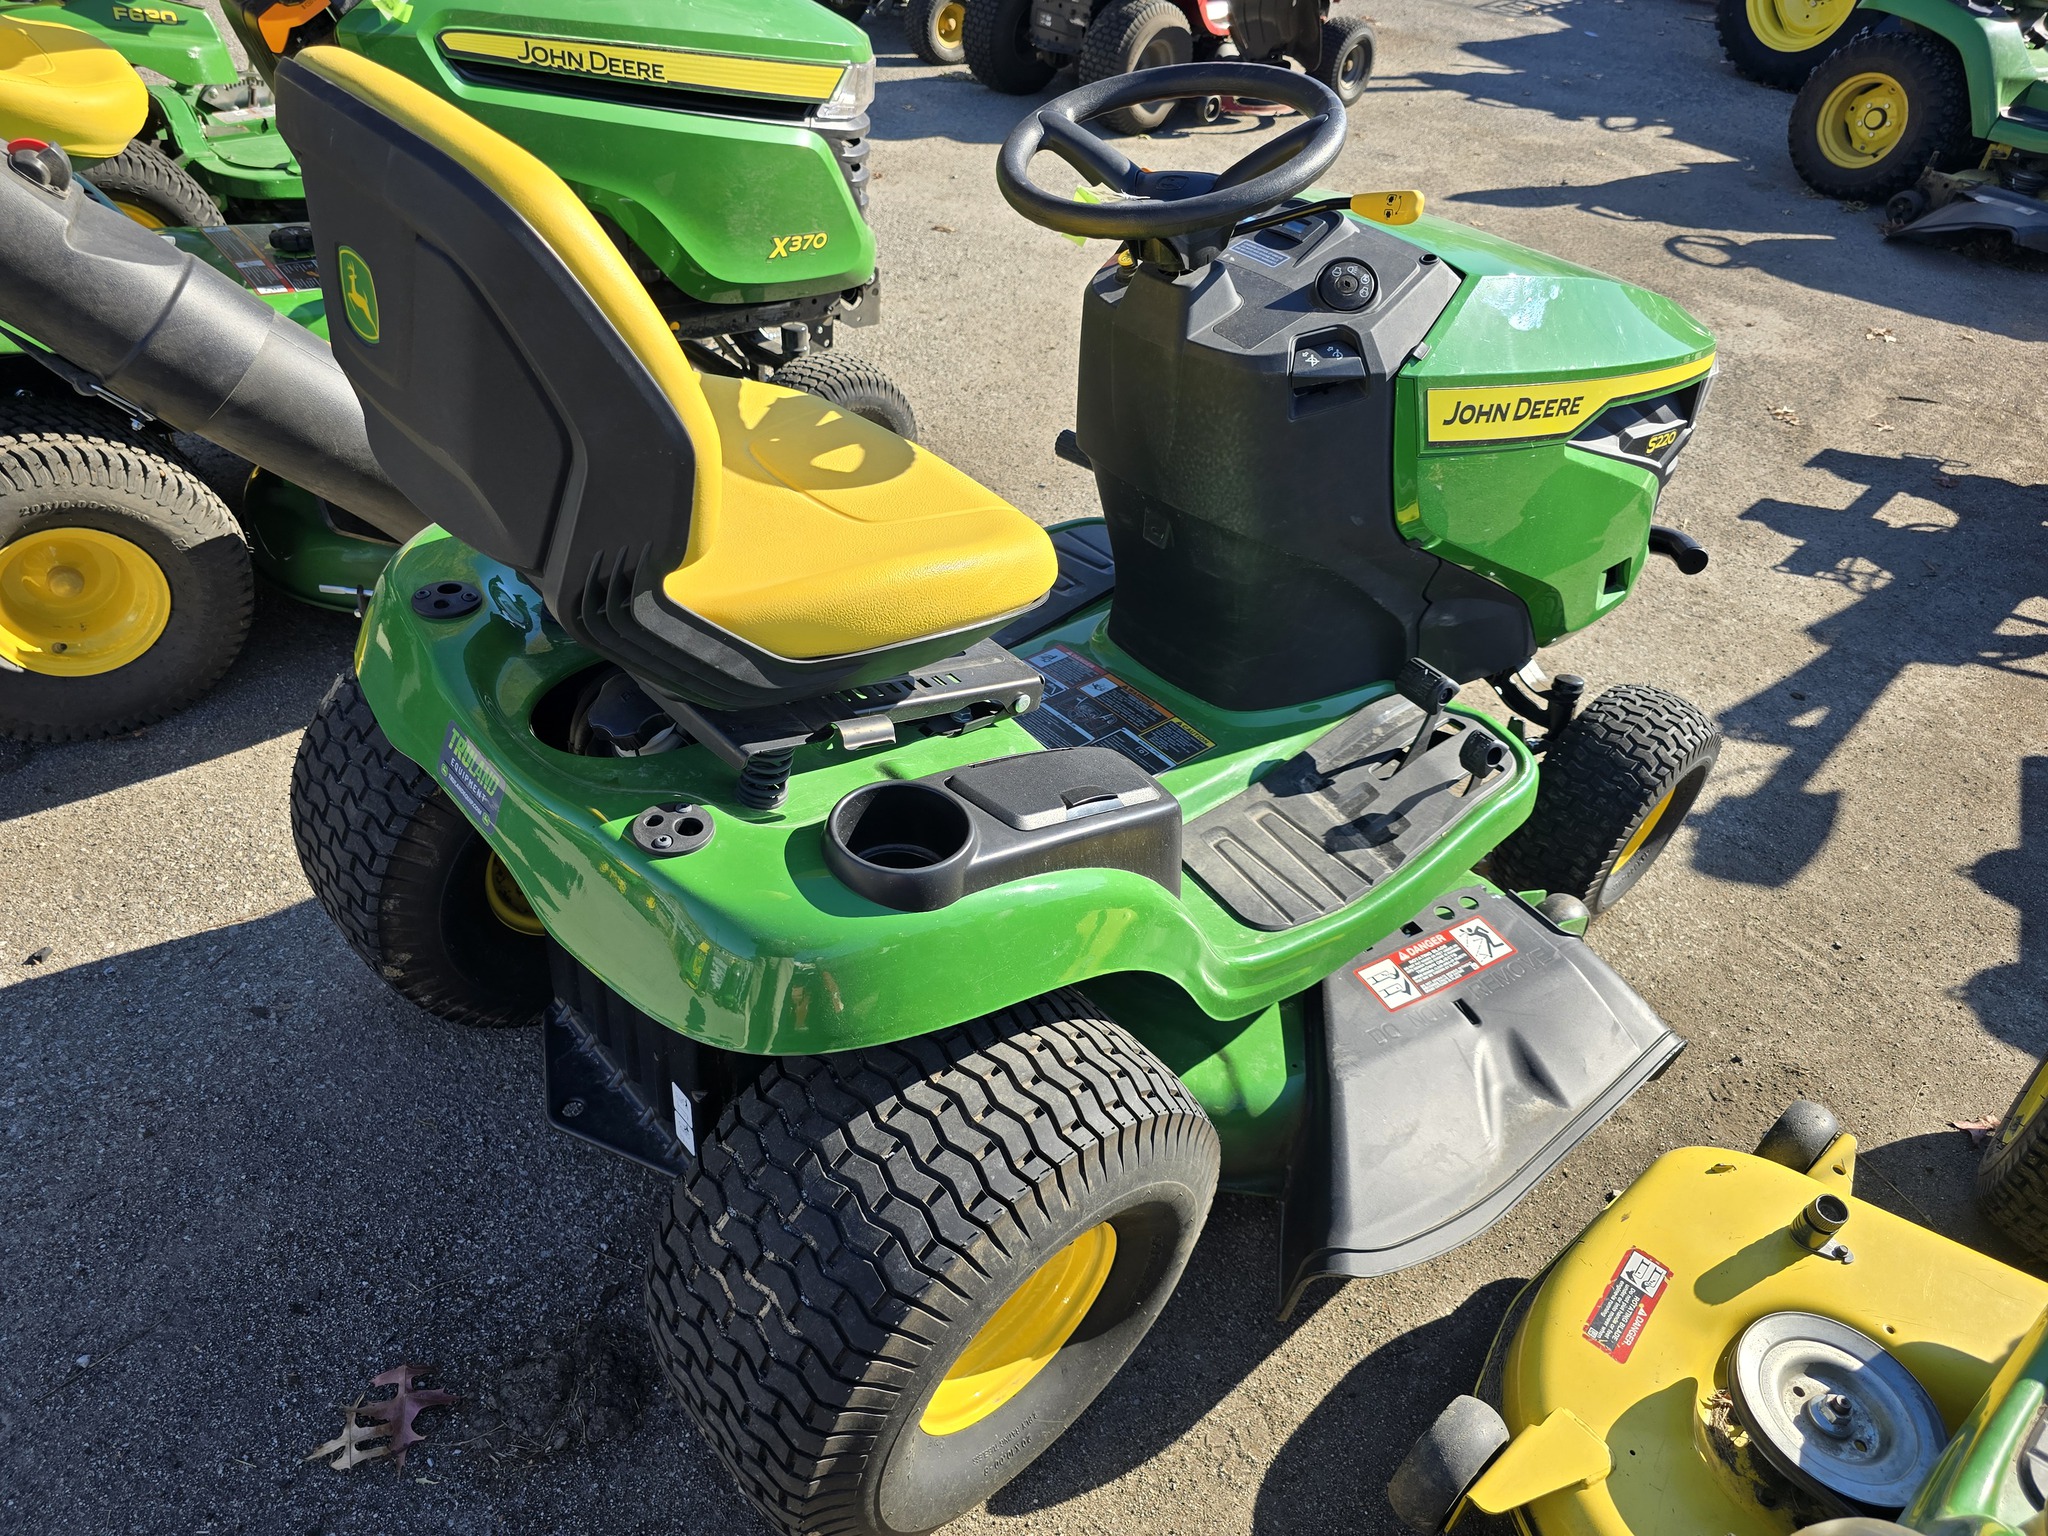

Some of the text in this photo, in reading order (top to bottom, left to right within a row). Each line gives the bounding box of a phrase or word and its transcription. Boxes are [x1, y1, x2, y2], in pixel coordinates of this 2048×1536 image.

[113, 6, 178, 25] F620
[518, 40, 666, 80] JOHN DEERE
[768, 232, 828, 259] X370
[1442, 395, 1585, 426] JOHN DEERE
[1645, 430, 1677, 454] S220
[1128, 686, 1155, 707] WARNING
[1181, 723, 1210, 744] CAUTION
[448, 728, 500, 797] TRULAND
[451, 758, 487, 802] EQUIPMENT
[1405, 934, 1447, 957] DANGER
[1611, 1294, 1640, 1342] ROTATING BLADE
[1622, 1314, 1644, 1346] DANGER
